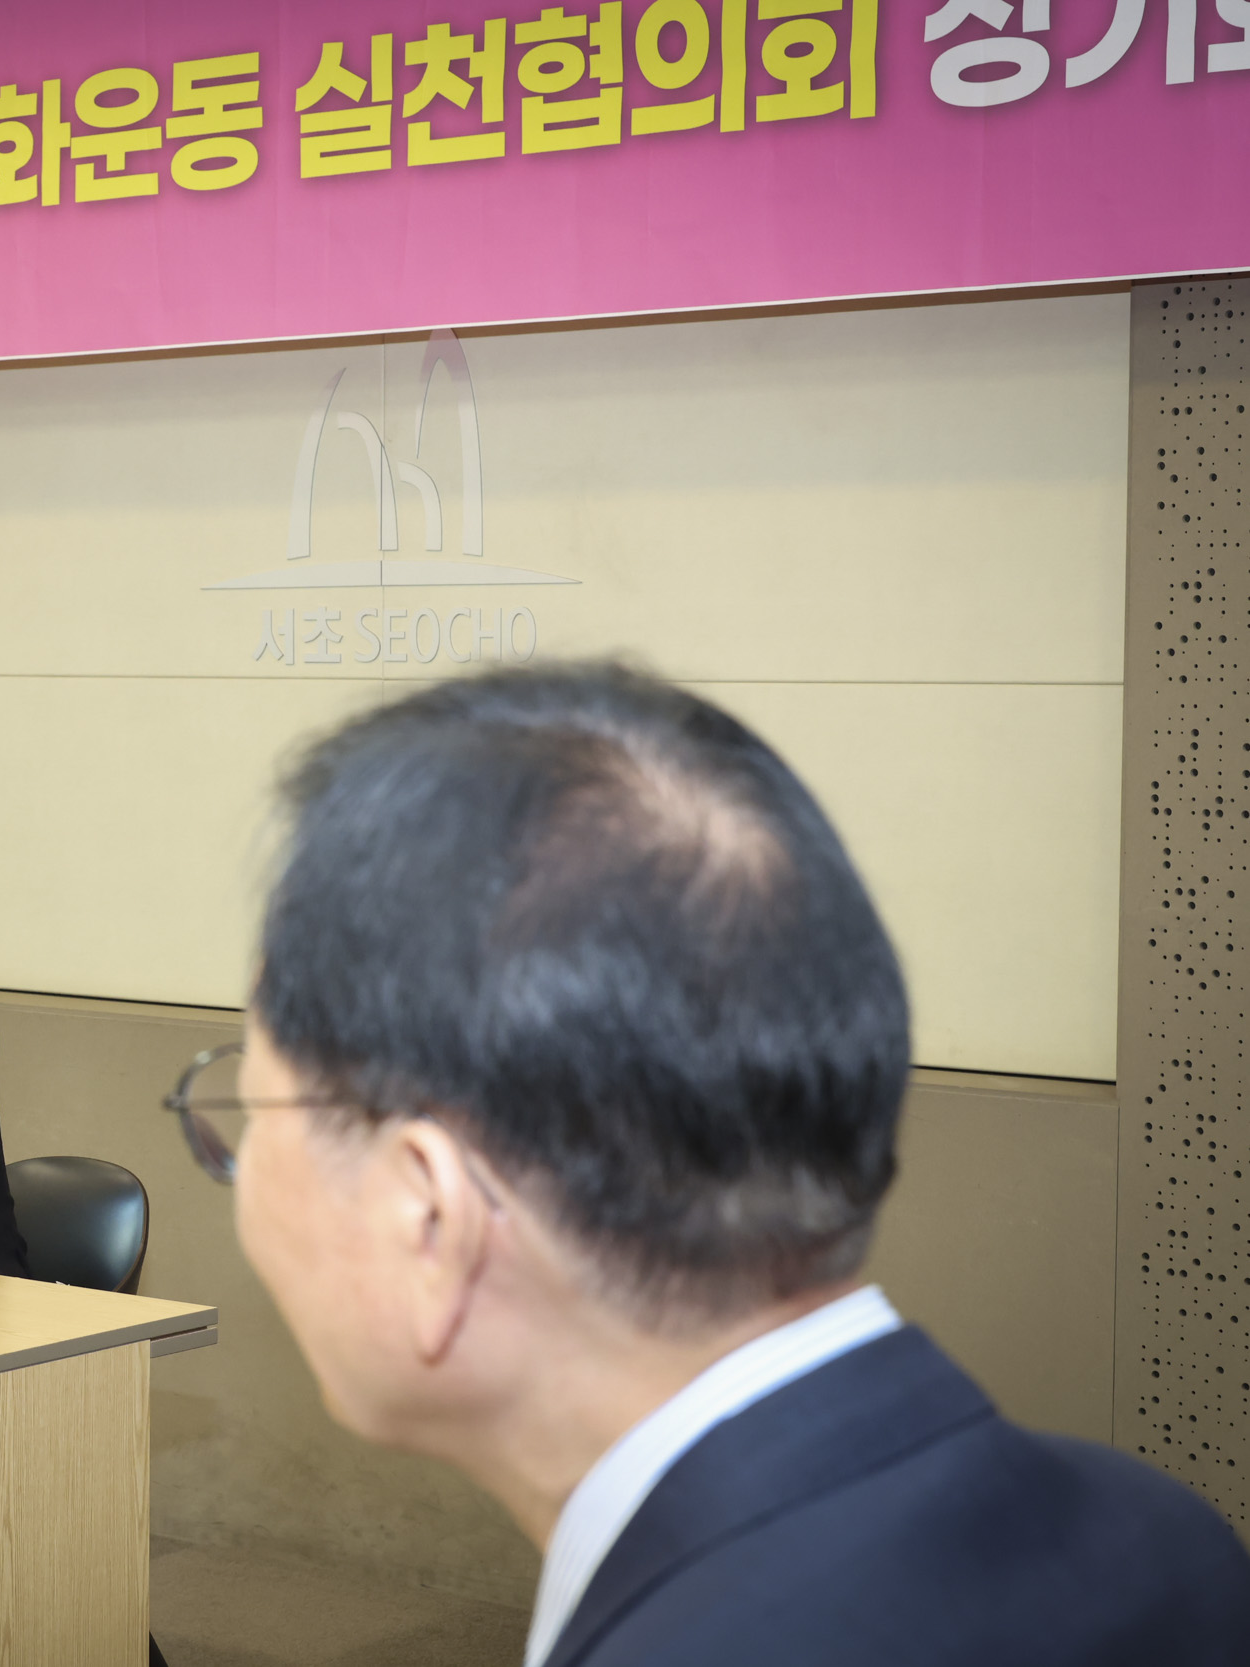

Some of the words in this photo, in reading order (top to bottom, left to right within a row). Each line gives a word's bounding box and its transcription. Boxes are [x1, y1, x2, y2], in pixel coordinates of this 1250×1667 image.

[294, 0, 878, 179] 실천협의회
[252, 606, 345, 667] 서초
[353, 605, 537, 664] SEOCHO
